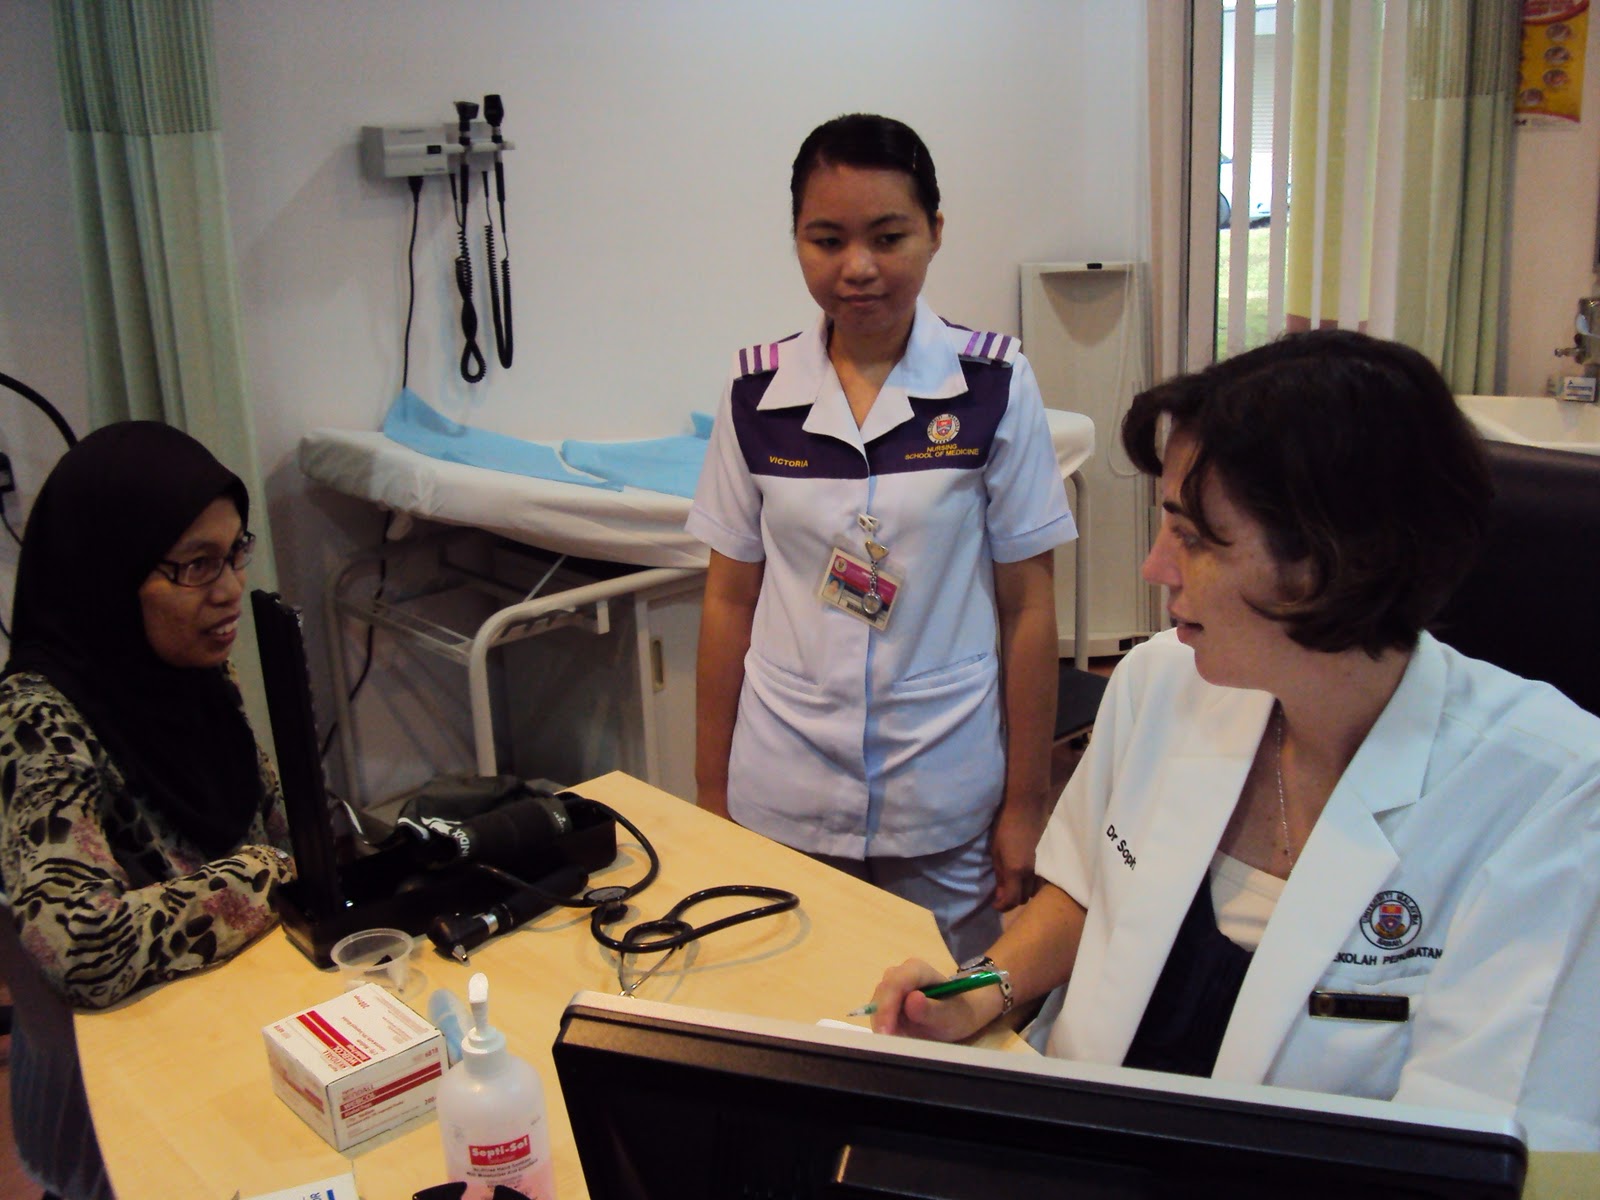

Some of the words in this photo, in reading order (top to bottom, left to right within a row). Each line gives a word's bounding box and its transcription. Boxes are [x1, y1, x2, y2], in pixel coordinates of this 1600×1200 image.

[905, 452, 933, 460] SCHOOL
[946, 448, 979, 457] MEDICINE
[927, 444, 957, 453] NURSING
[769, 456, 809, 468] VICTORIA
[1106, 824, 1118, 841] Dr
[472, 1138, 529, 1159] Septi-Sol
